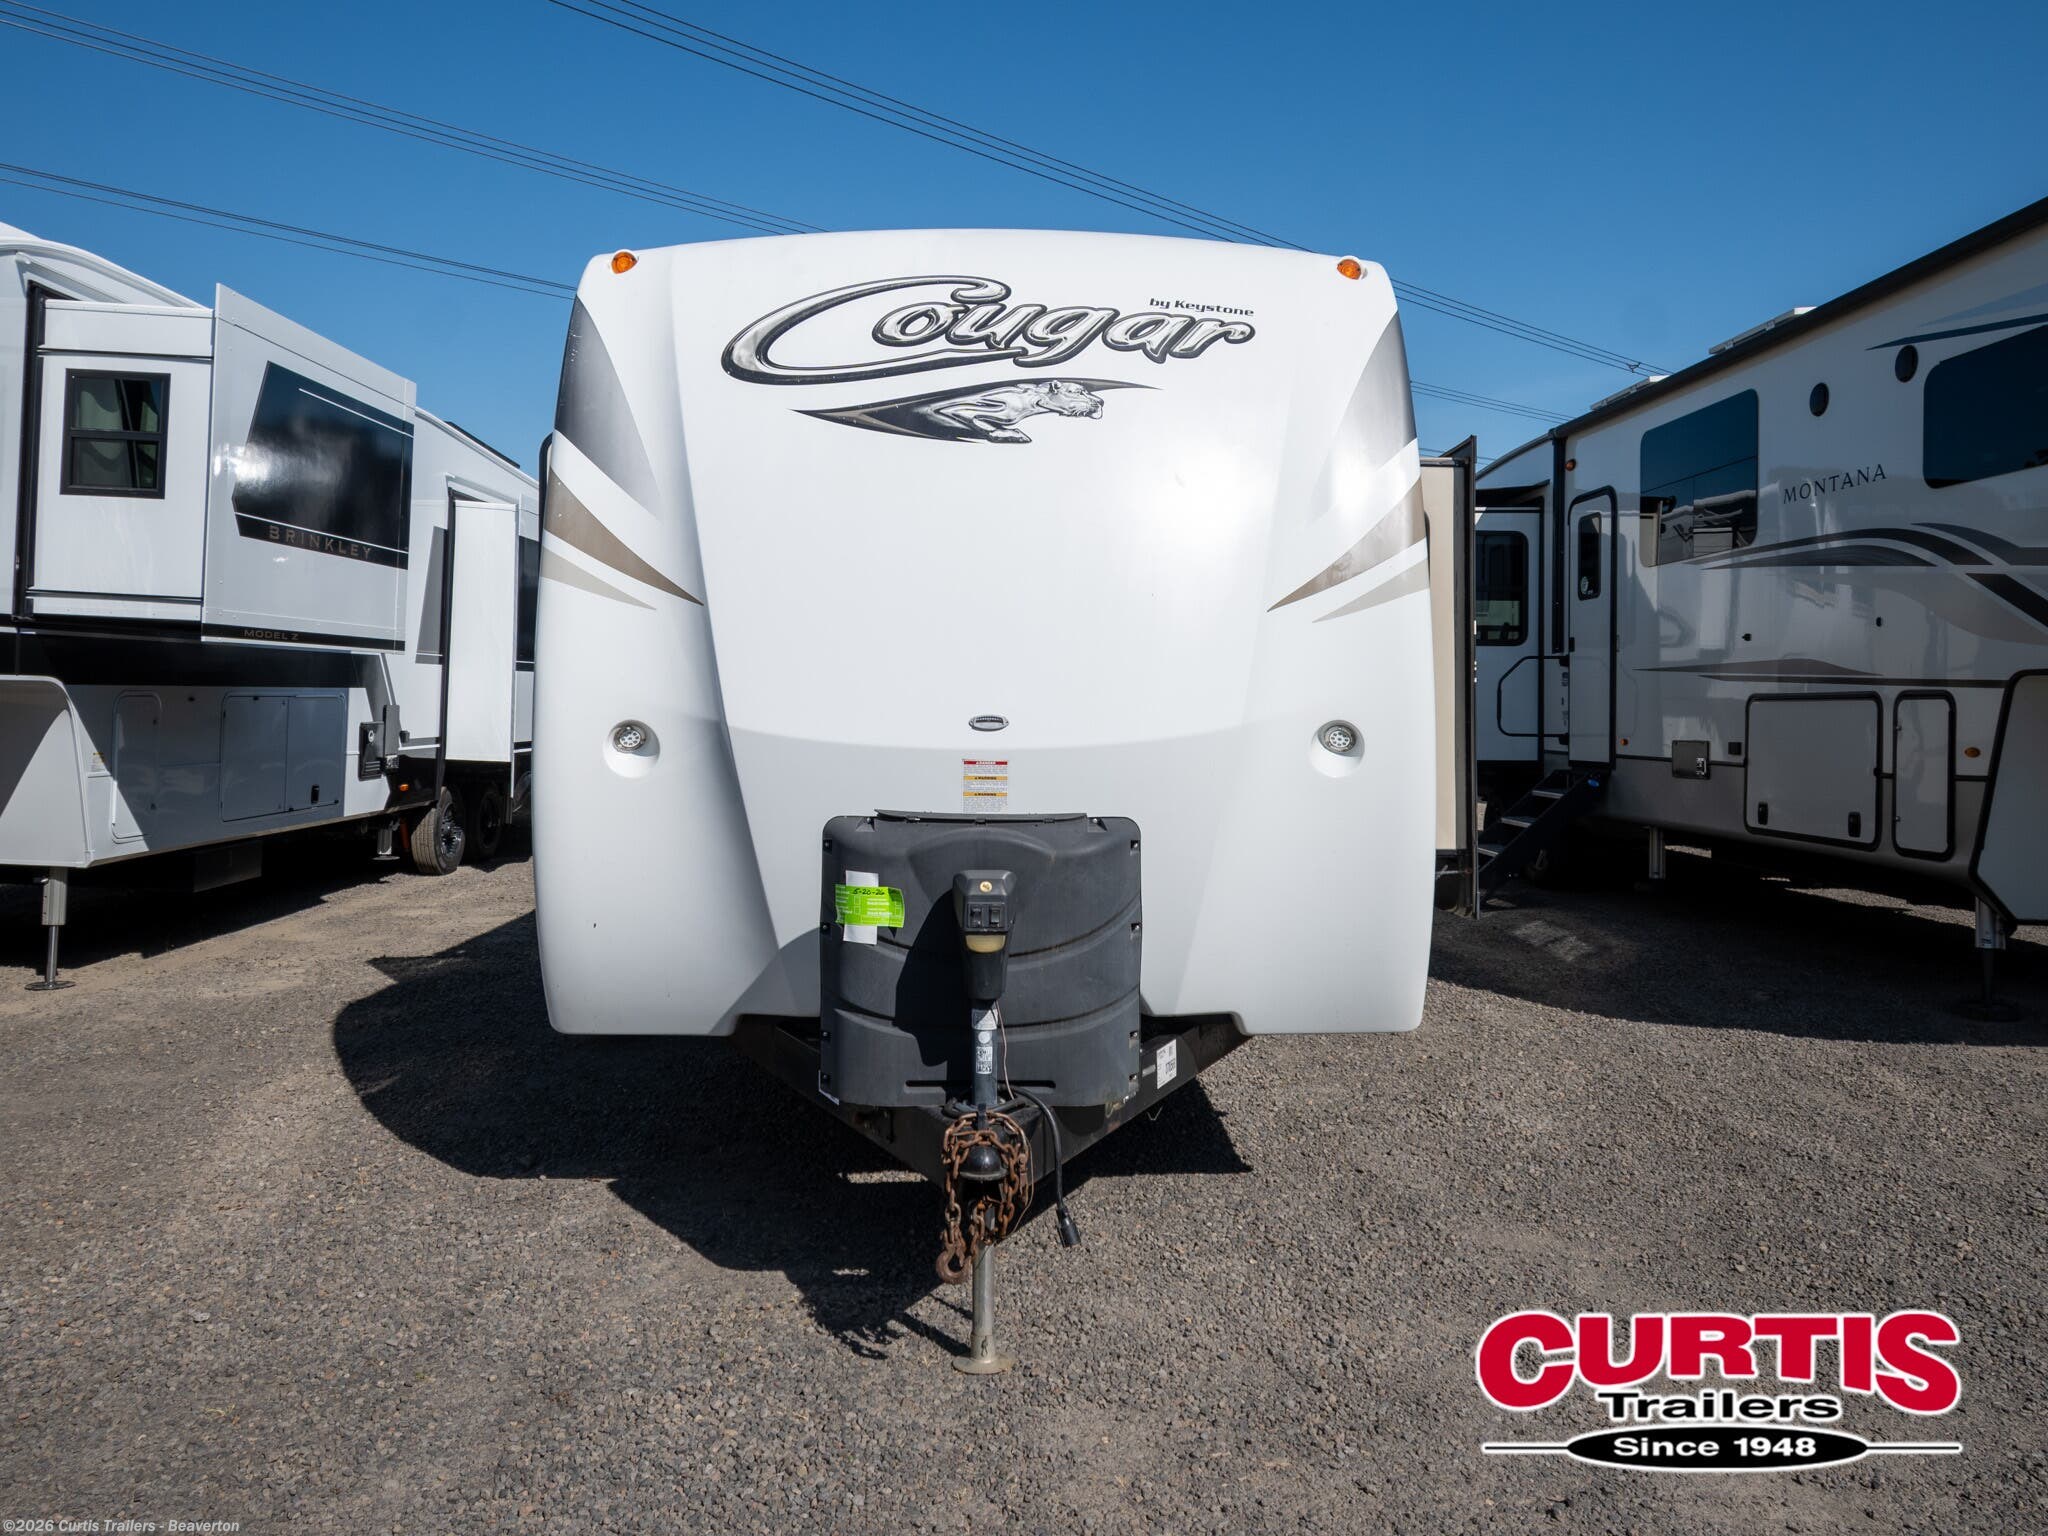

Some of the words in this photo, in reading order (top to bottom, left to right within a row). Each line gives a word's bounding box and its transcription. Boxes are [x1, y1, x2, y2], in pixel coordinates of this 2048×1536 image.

[1149, 298, 1171, 310] by
[1174, 300, 1254, 316] Keystone
[720, 275, 1255, 386] Cougar
[1783, 463, 1887, 504] MONTANA
[269, 525, 372, 559] BRINKLEY
[244, 629, 288, 641] MODEL
[291, 633, 299, 641] Z
